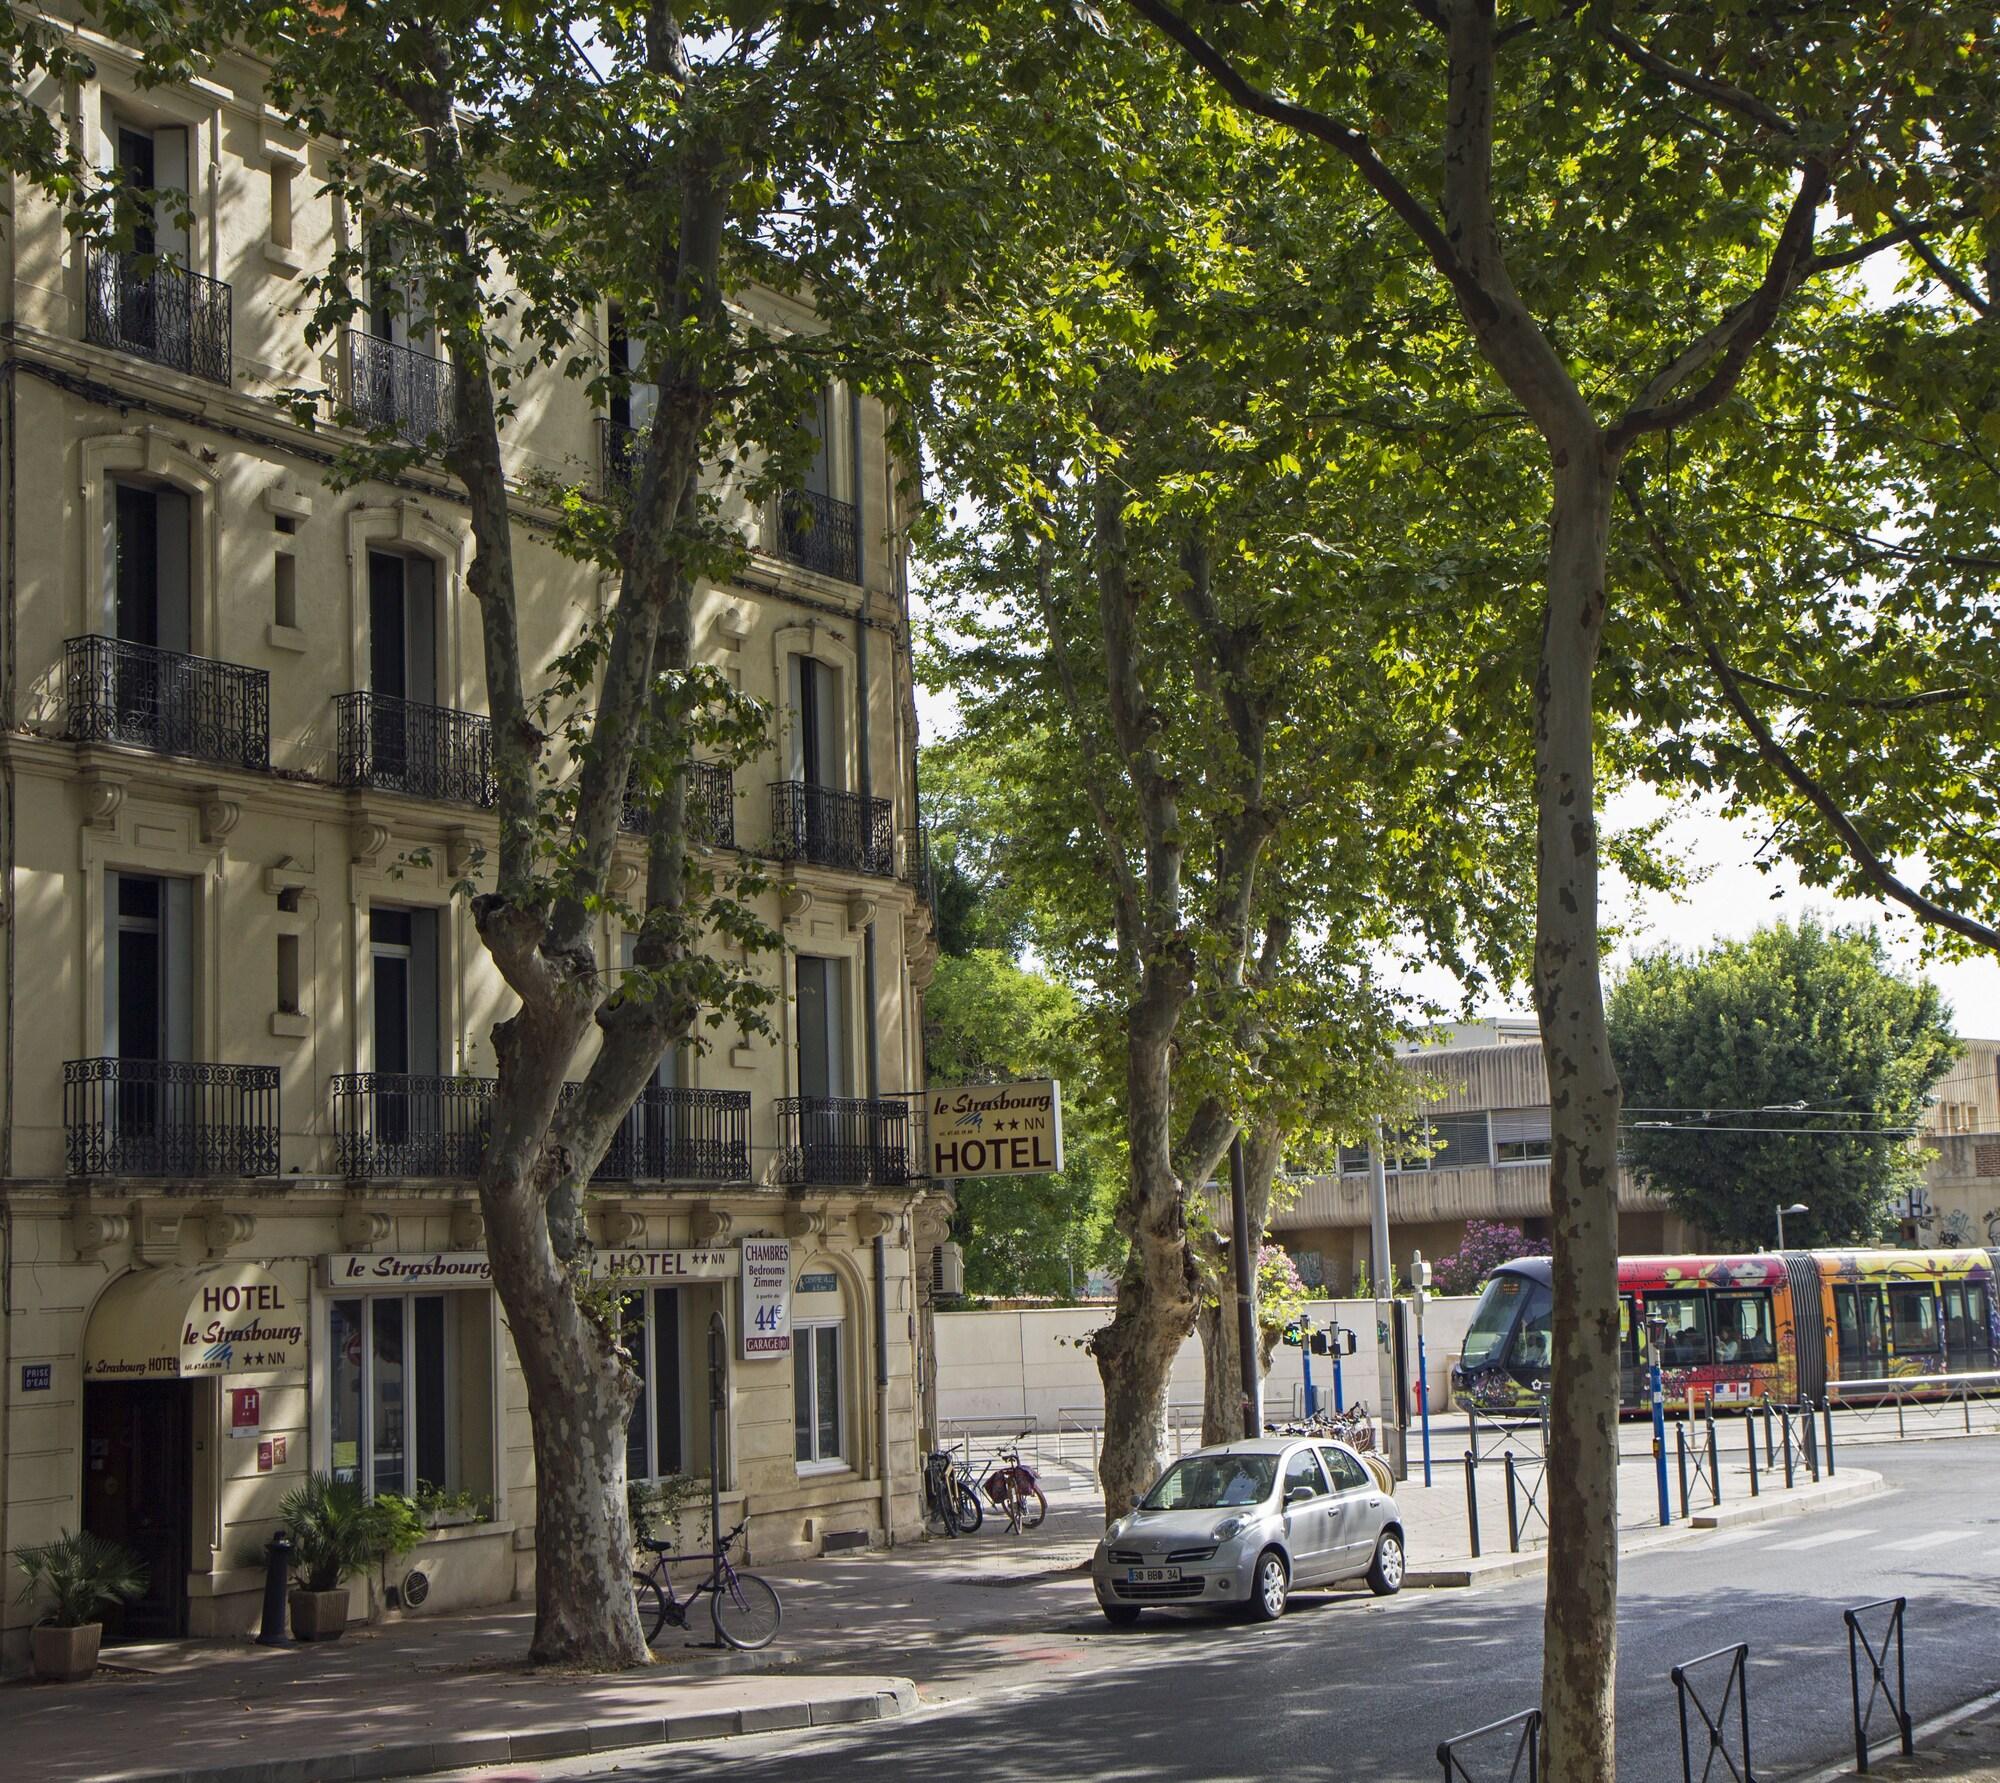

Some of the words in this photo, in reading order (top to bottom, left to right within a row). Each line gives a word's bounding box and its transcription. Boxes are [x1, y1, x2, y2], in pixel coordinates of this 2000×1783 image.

[933, 1096, 949, 1115] le
[952, 1089, 1052, 1112] Strasbourg
[1023, 1117, 1045, 1130] NN
[934, 1136, 1051, 1173] HOTEL
[745, 1244, 788, 1261] CHAMBRES
[346, 1257, 365, 1277] le
[372, 1255, 491, 1279] Strasbourg
[609, 1253, 687, 1275] HOTEL
[711, 1253, 725, 1265] NN
[748, 1264, 785, 1275] Bedrooms
[753, 1277, 782, 1287] Zimmer
[203, 1285, 285, 1312] HOTEL
[755, 1304, 783, 1330] 44€
[182, 1323, 198, 1345] le
[202, 1317, 302, 1345] Strasbourg
[747, 1338, 779, 1351] GARAGE
[84, 1360, 92, 1374] le
[95, 1359, 146, 1376] Strasbourg
[148, 1357, 178, 1371] HOTEL
[268, 1352, 285, 1364] NN
[26, 1368, 49, 1378] PRISE
[26, 1378, 49, 1387] D'EAU
[244, 1394, 256, 1409] H
